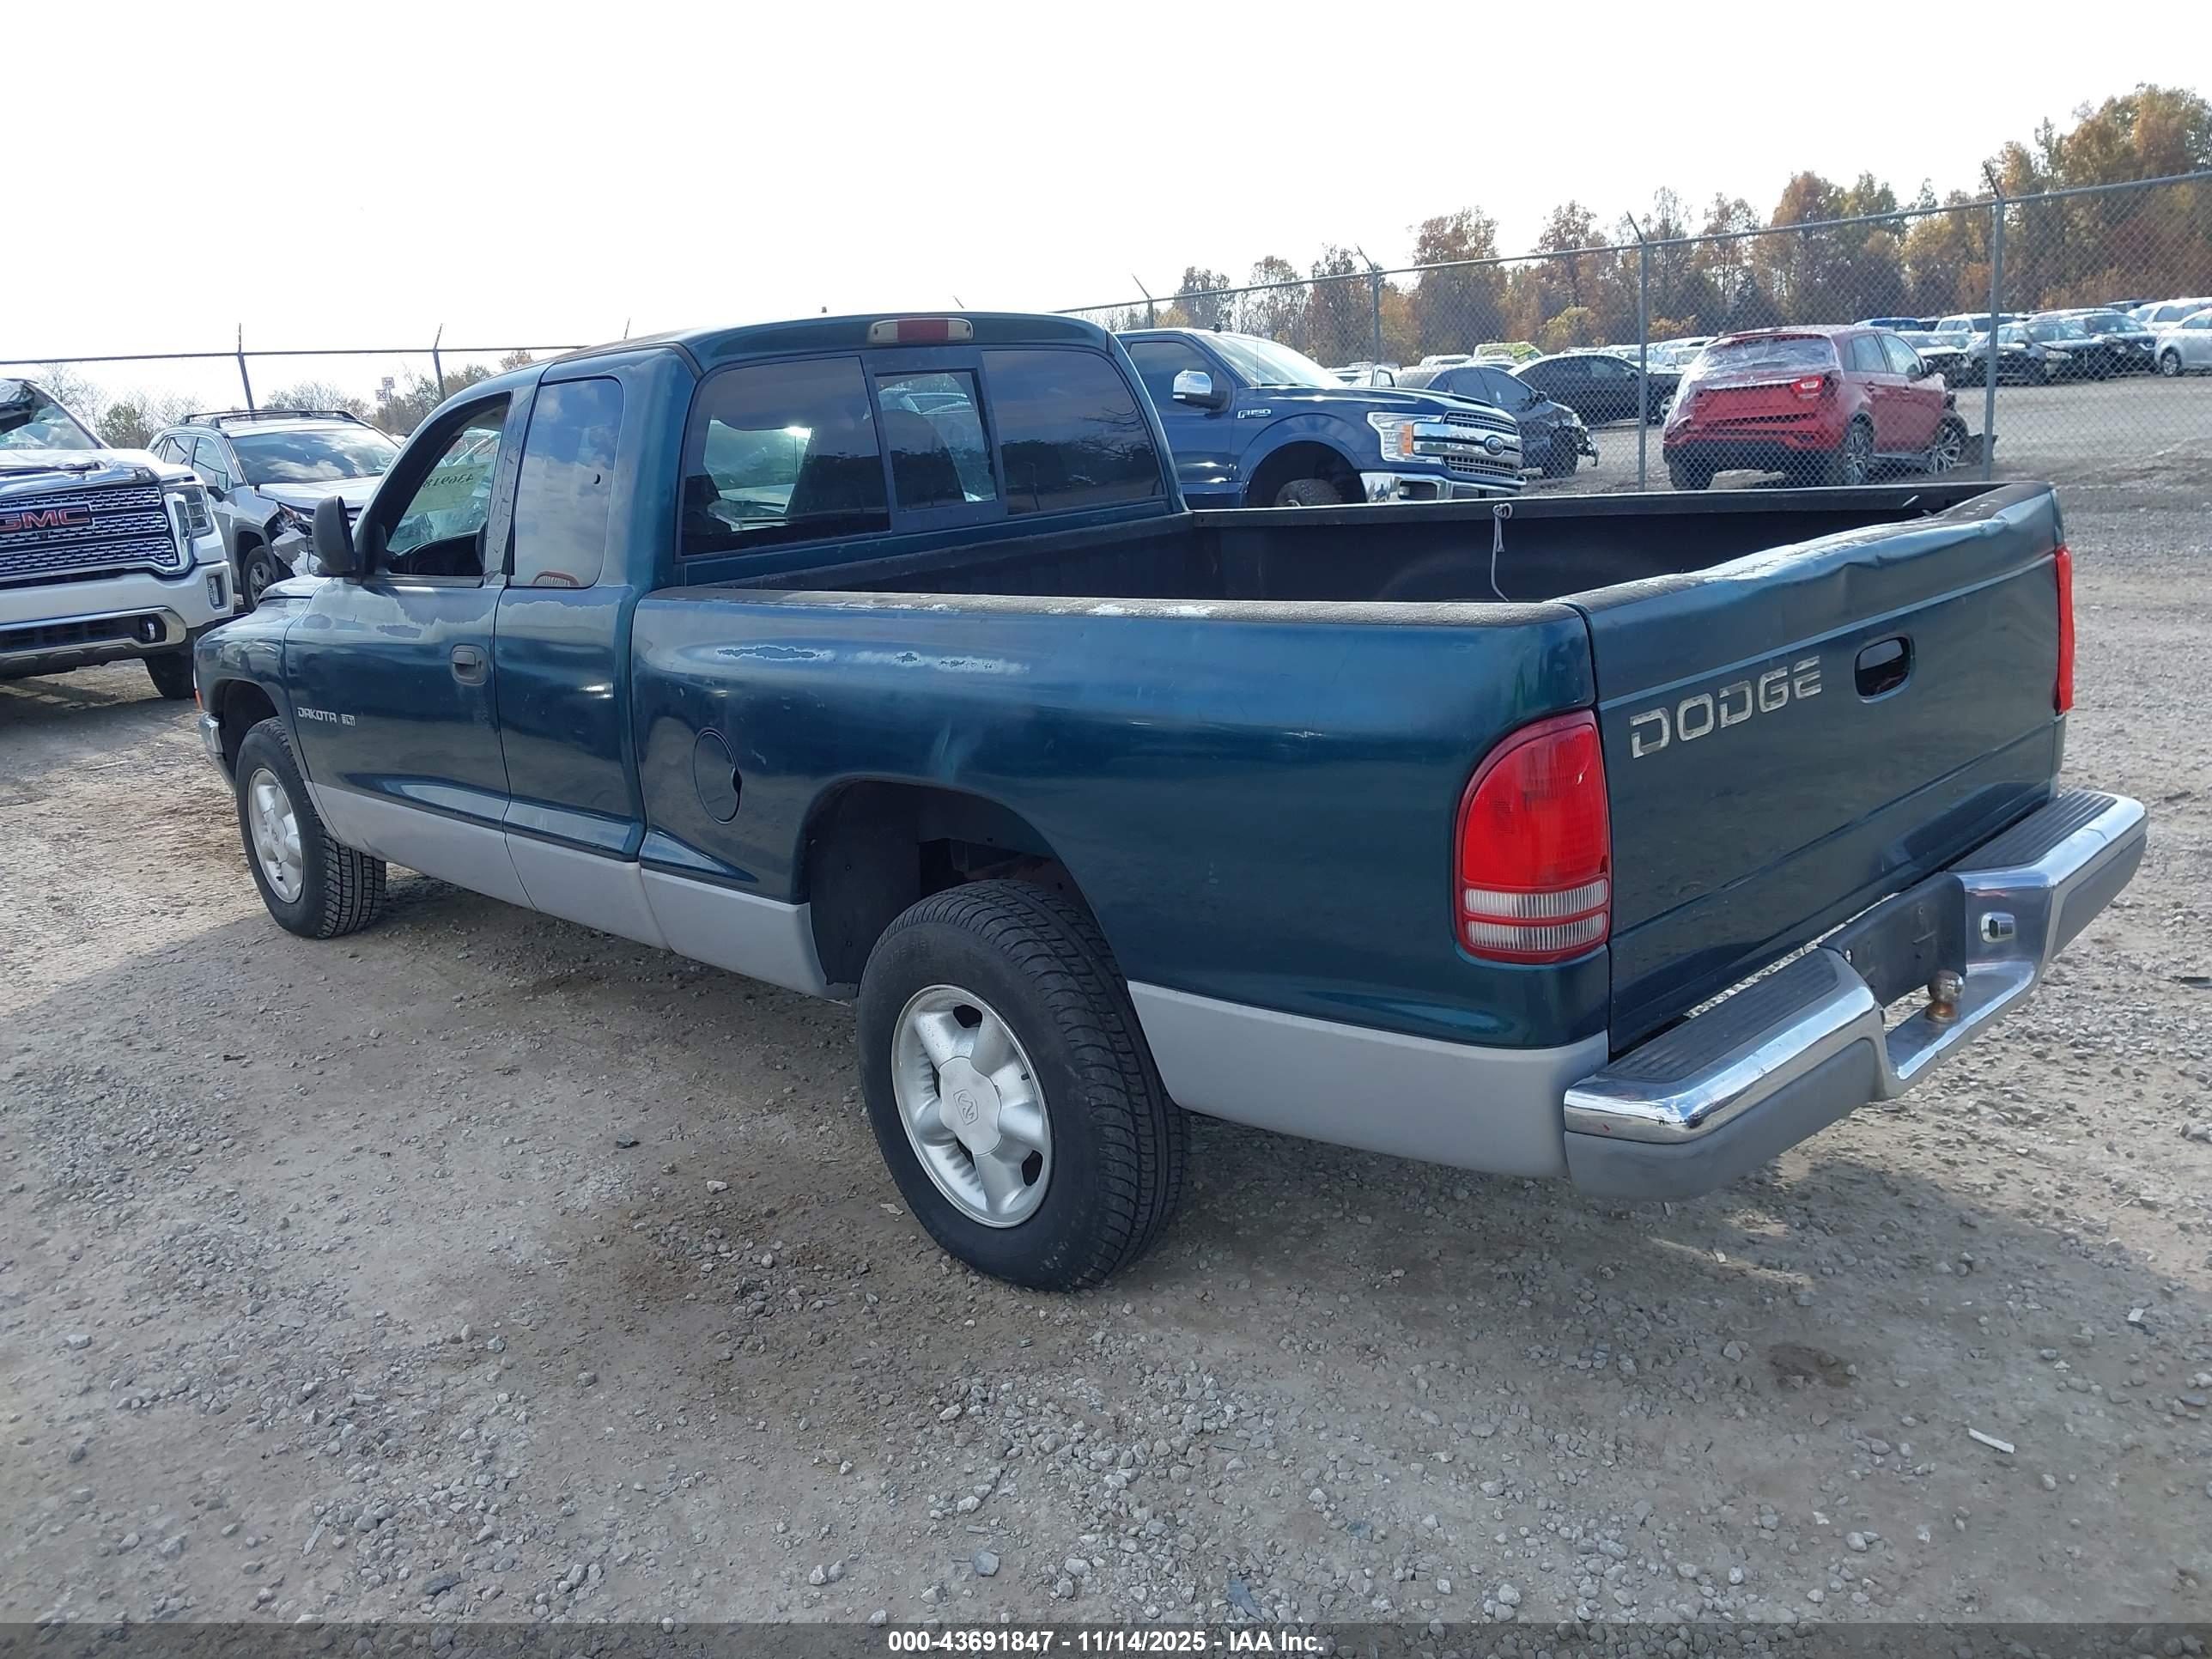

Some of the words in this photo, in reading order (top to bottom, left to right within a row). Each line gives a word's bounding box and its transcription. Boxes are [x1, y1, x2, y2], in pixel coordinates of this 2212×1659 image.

[0, 507, 90, 532] GMC
[297, 707, 337, 723] DAKOTA
[1629, 654, 1822, 760] DODGE
